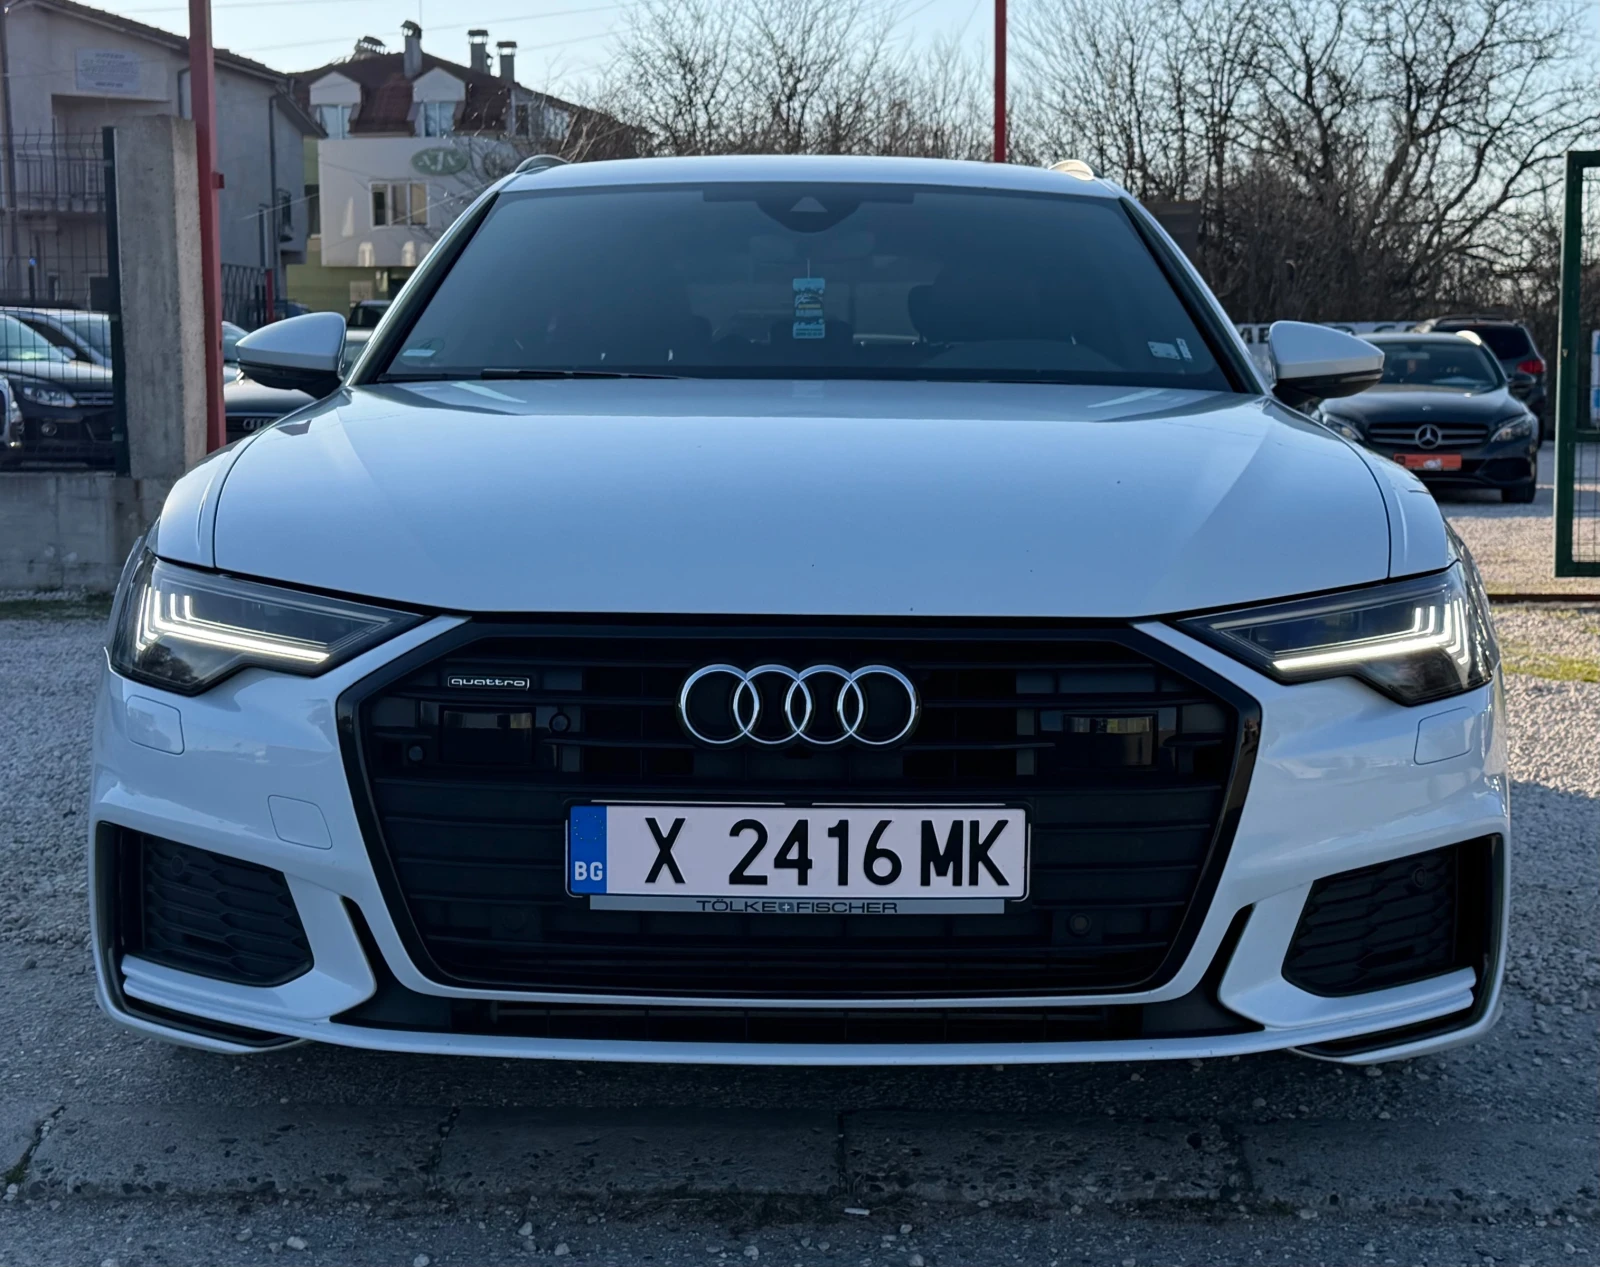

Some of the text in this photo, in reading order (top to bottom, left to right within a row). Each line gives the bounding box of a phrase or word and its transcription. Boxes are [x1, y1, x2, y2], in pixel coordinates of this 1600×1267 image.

[450, 678, 526, 687] quattro
[644, 817, 1010, 887] X 2416 MK
[574, 861, 603, 881] BG
[696, 898, 899, 914] TÖLKE FISCHER
